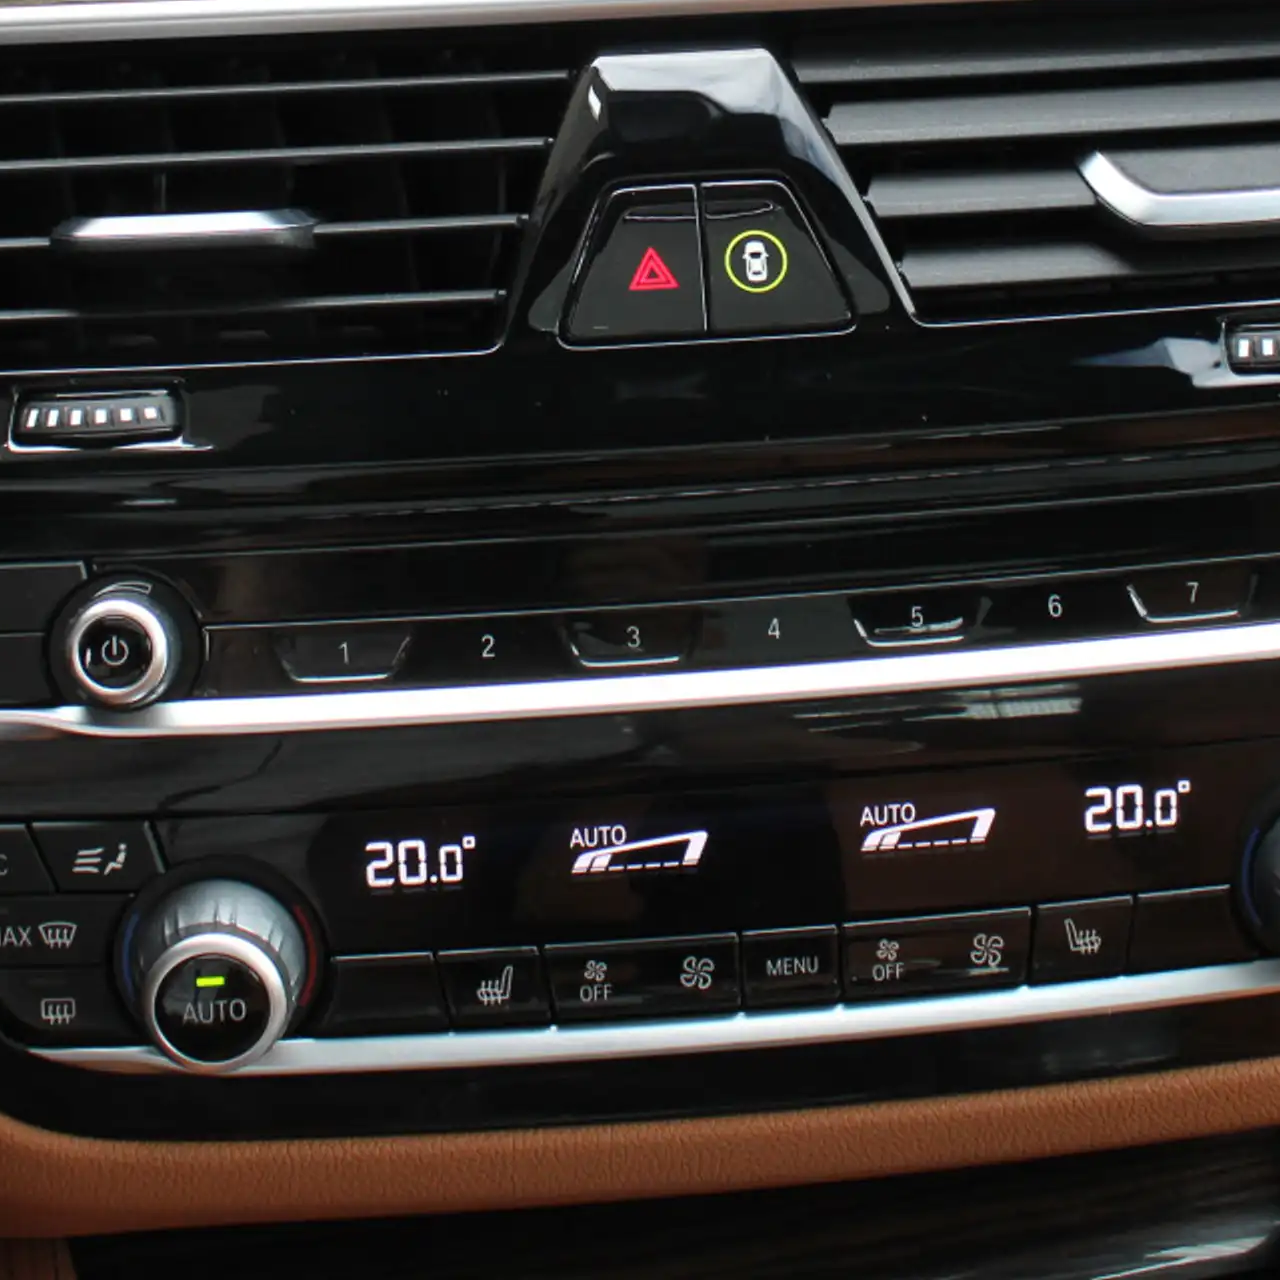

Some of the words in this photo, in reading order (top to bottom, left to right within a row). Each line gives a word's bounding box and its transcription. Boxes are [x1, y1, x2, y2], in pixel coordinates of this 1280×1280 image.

[1186, 580, 1200, 604] 7
[909, 604, 925, 629] 5
[1046, 594, 1064, 619] 6
[625, 625, 642, 650] 3
[766, 617, 782, 641] 4
[338, 641, 350, 665] 1
[480, 634, 496, 659] 2
[859, 801, 917, 826] AUTO
[569, 823, 627, 848] AUTO
[765, 955, 820, 977] MENU
[871, 962, 906, 982] OFF
[578, 984, 613, 1003] OFF
[181, 998, 248, 1025] AUTO
